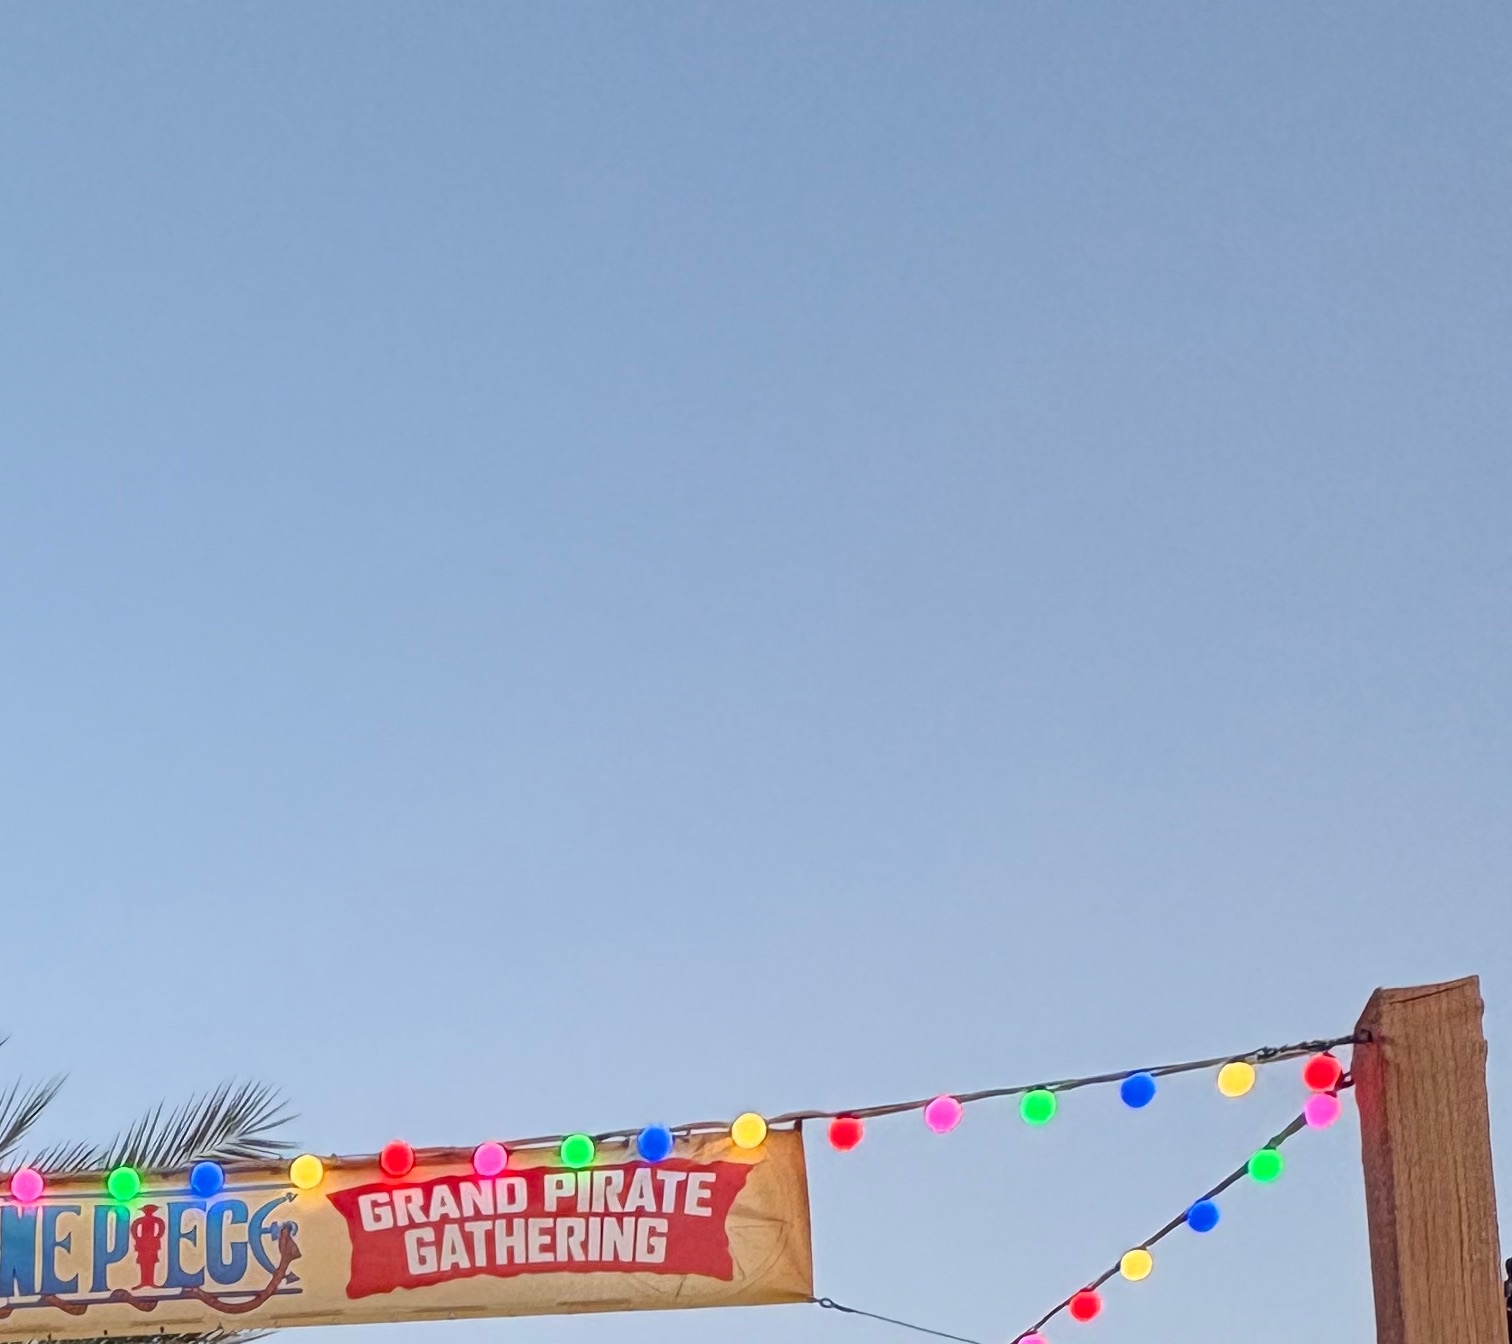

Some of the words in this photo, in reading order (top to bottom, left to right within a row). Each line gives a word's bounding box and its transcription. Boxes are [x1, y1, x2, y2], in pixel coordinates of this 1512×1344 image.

[357, 1175, 528, 1232] GRAND
[542, 1166, 717, 1217] PIRATE
[90, 1192, 300, 1295] PIECE
[403, 1216, 670, 1276] GATHERING
